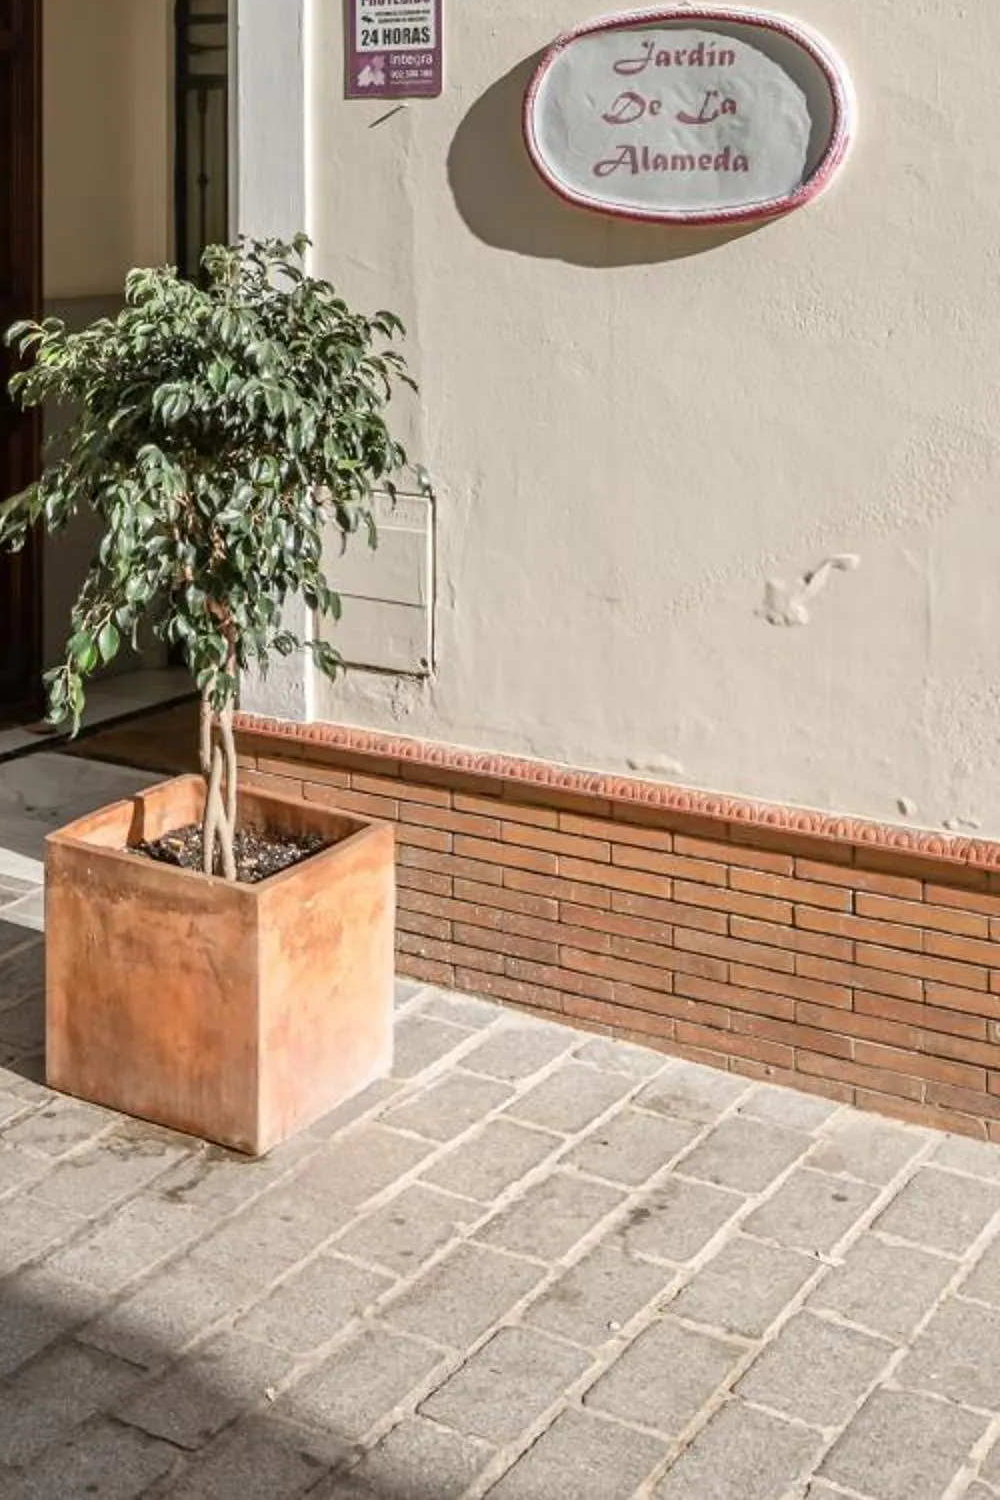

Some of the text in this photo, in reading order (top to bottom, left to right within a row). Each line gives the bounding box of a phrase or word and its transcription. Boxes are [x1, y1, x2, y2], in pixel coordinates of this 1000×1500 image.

[361, 26, 431, 46] 24 HORAS
[390, 53, 433, 67] integra
[603, 90, 738, 125] De La
[593, 145, 750, 177] Alameda
